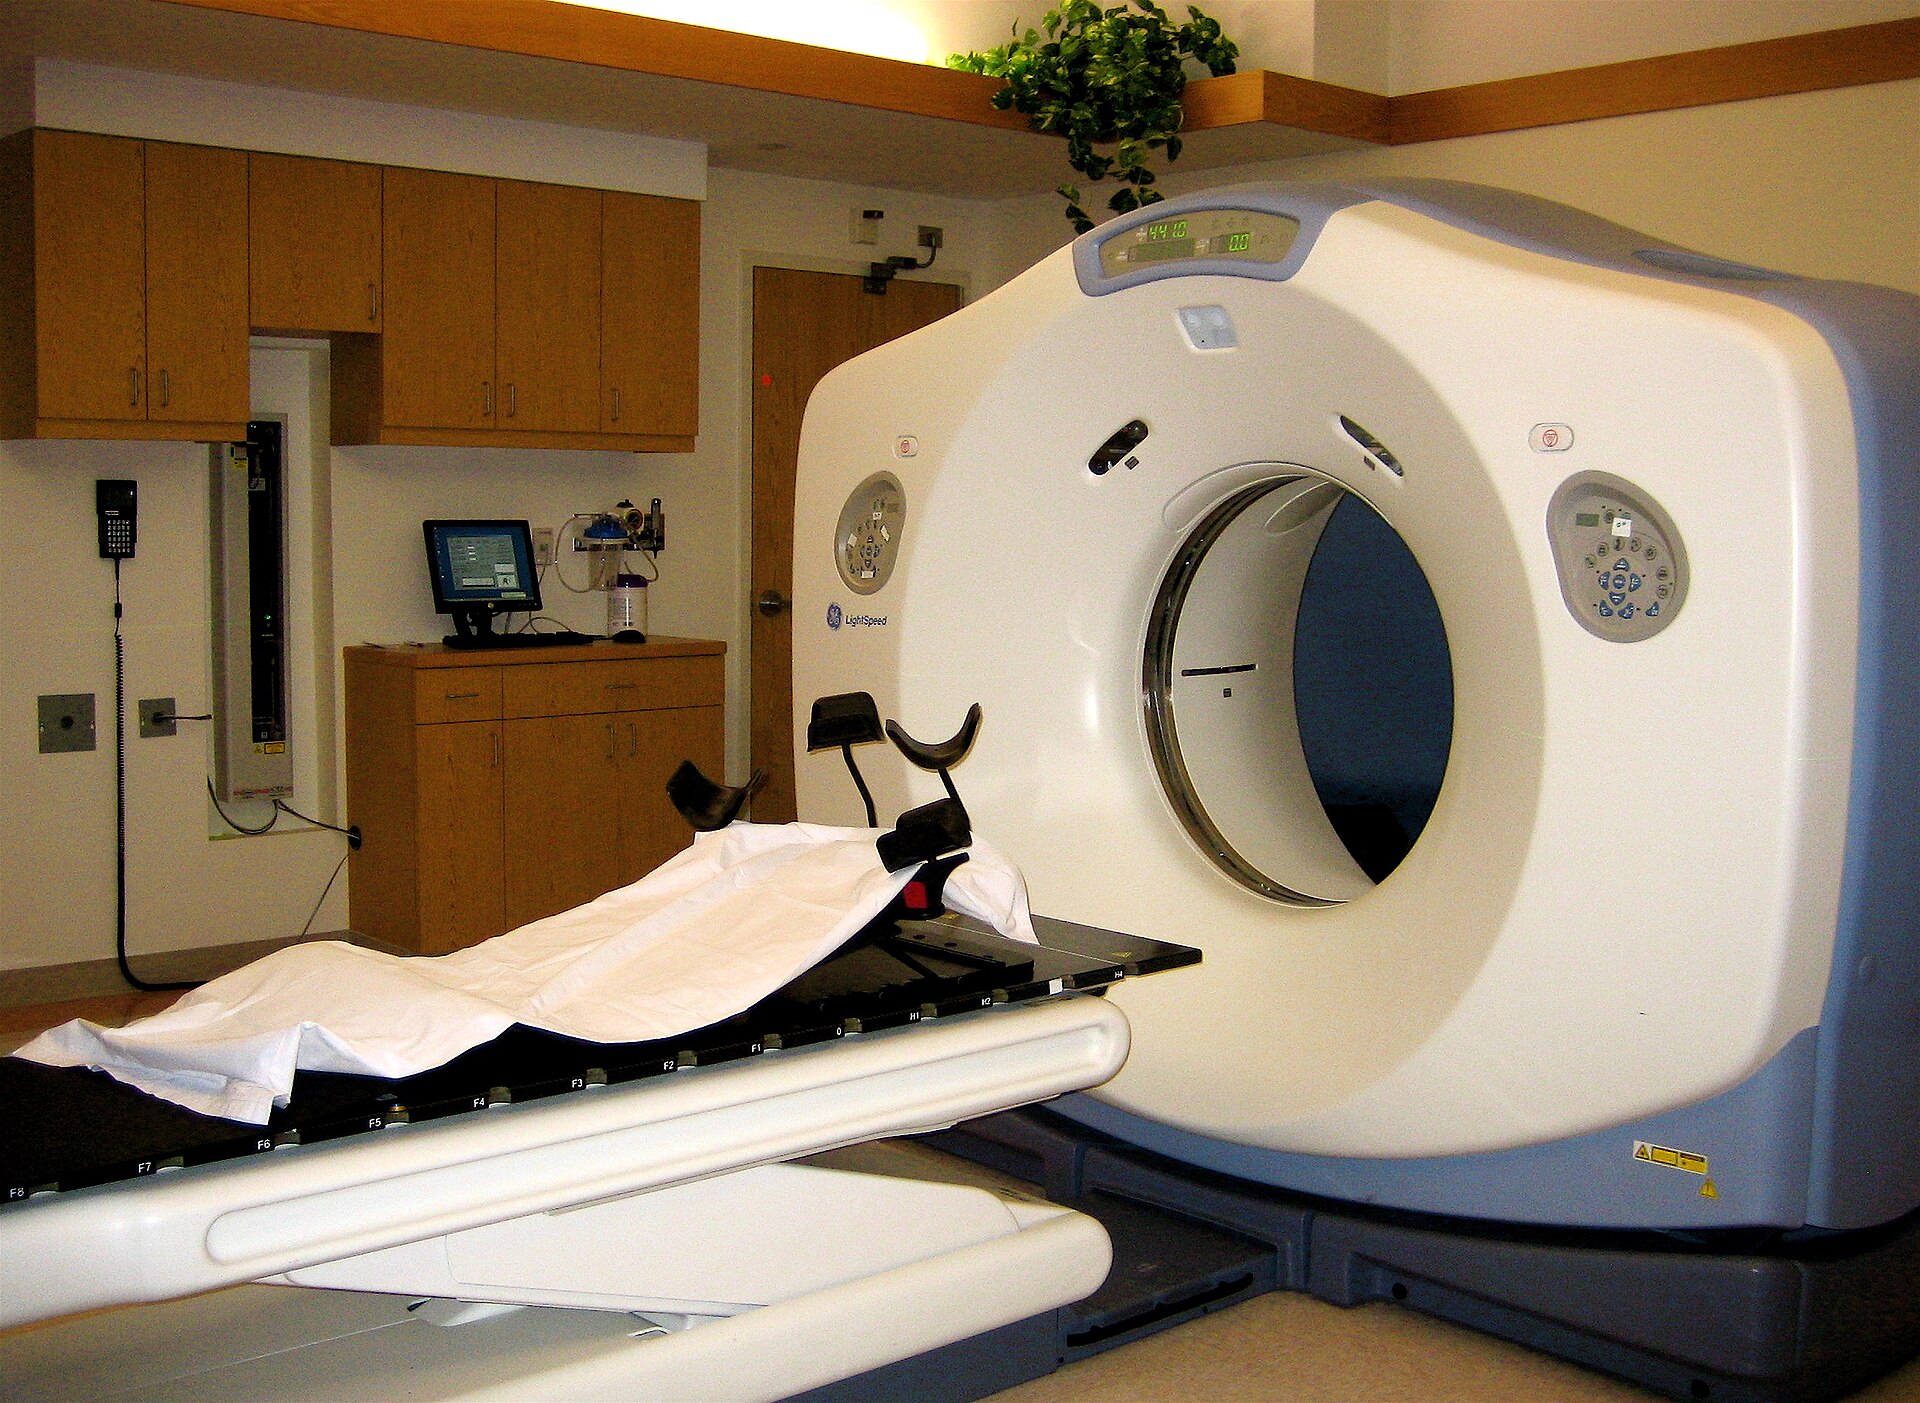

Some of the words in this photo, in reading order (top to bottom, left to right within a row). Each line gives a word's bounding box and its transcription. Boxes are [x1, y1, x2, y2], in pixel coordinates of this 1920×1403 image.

[845, 615, 887, 627] LightSpeed
[981, 997, 991, 1006] H2
[909, 1011, 920, 1021] H1
[751, 1043, 761, 1053] F1
[663, 1060, 674, 1071] F2
[571, 1078, 583, 1089] F3
[473, 1097, 485, 1108] F4
[368, 1117, 382, 1129] F5
[257, 1138, 271, 1150] F6
[138, 1161, 152, 1174] F7
[9, 1187, 25, 1198] F8
